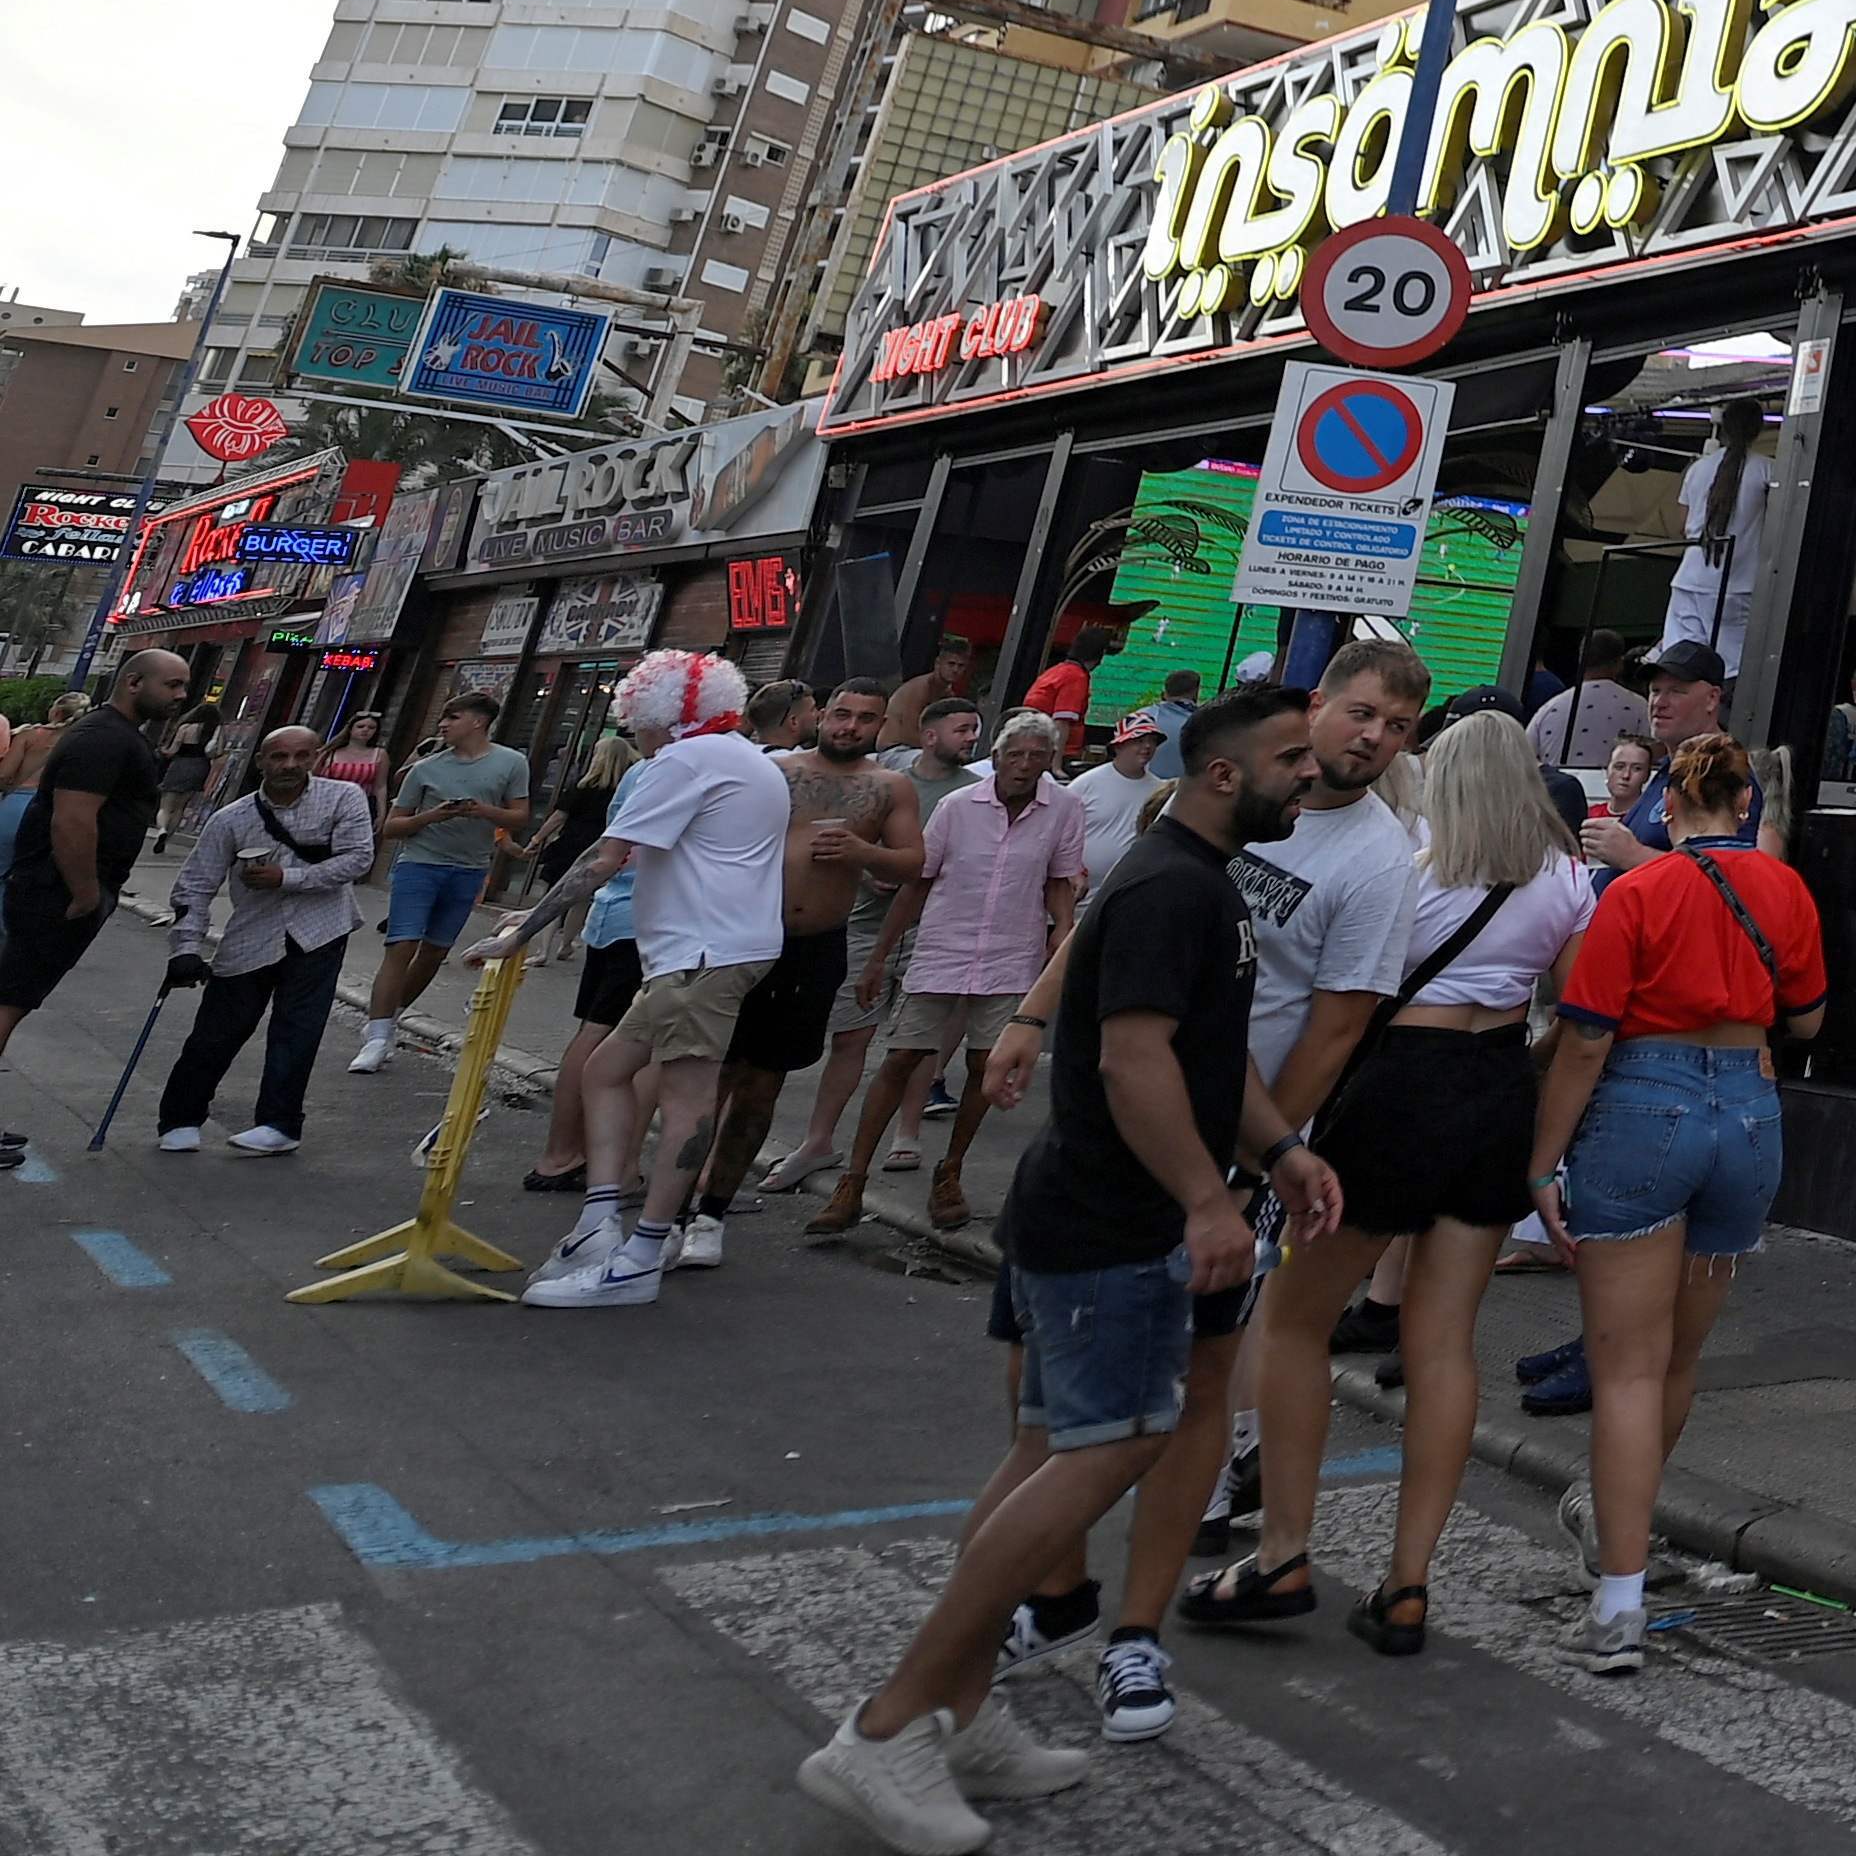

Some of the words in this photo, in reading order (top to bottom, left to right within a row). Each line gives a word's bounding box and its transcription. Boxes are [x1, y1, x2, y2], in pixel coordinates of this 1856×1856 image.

[1342, 265, 1436, 317] 20
[467, 314, 544, 349] JAIL
[869, 312, 962, 384] NIGHT
[960, 293, 1041, 362] CLUB
[310, 341, 377, 370] TOP
[459, 345, 540, 380] ROCK
[441, 374, 471, 388] LIVE
[478, 378, 520, 395] MUSIC
[524, 387, 552, 399] BAR
[478, 462, 568, 528] JAIL
[567, 434, 699, 514] ROCK
[35, 491, 106, 505] NIGHT
[1265, 492, 1344, 510] EXPENDEDOR
[1350, 501, 1396, 516] TICKETS
[1281, 514, 1305, 525] ZONA
[1308, 518, 1319, 526] DE
[244, 535, 342, 557] BURGER
[481, 535, 524, 562] LIVE
[536, 525, 604, 555] MUSIC
[616, 515, 665, 541] BAR
[1262, 533, 1297, 544] TICKETS
[1299, 537, 1311, 546] DE
[1313, 538, 1353, 550] CONTROL
[1355, 543, 1409, 556] OBLIGATORIO
[1284, 525, 1323, 537] LIMITADO
[1333, 531, 1391, 544] CONTROLADO
[1277, 551, 1330, 565] HORARIO
[1335, 557, 1350, 567] DE
[1355, 559, 1386, 570] PAGO
[1248, 565, 1277, 575] LUNES
[1338, 573, 1344, 581] A
[1251, 586, 1298, 599] DOMINGOS
[1301, 590, 1306, 599] Y
[1354, 595, 1394, 607] GRATUITO
[1336, 584, 1342, 592] A
[323, 654, 375, 668] KEBAB
